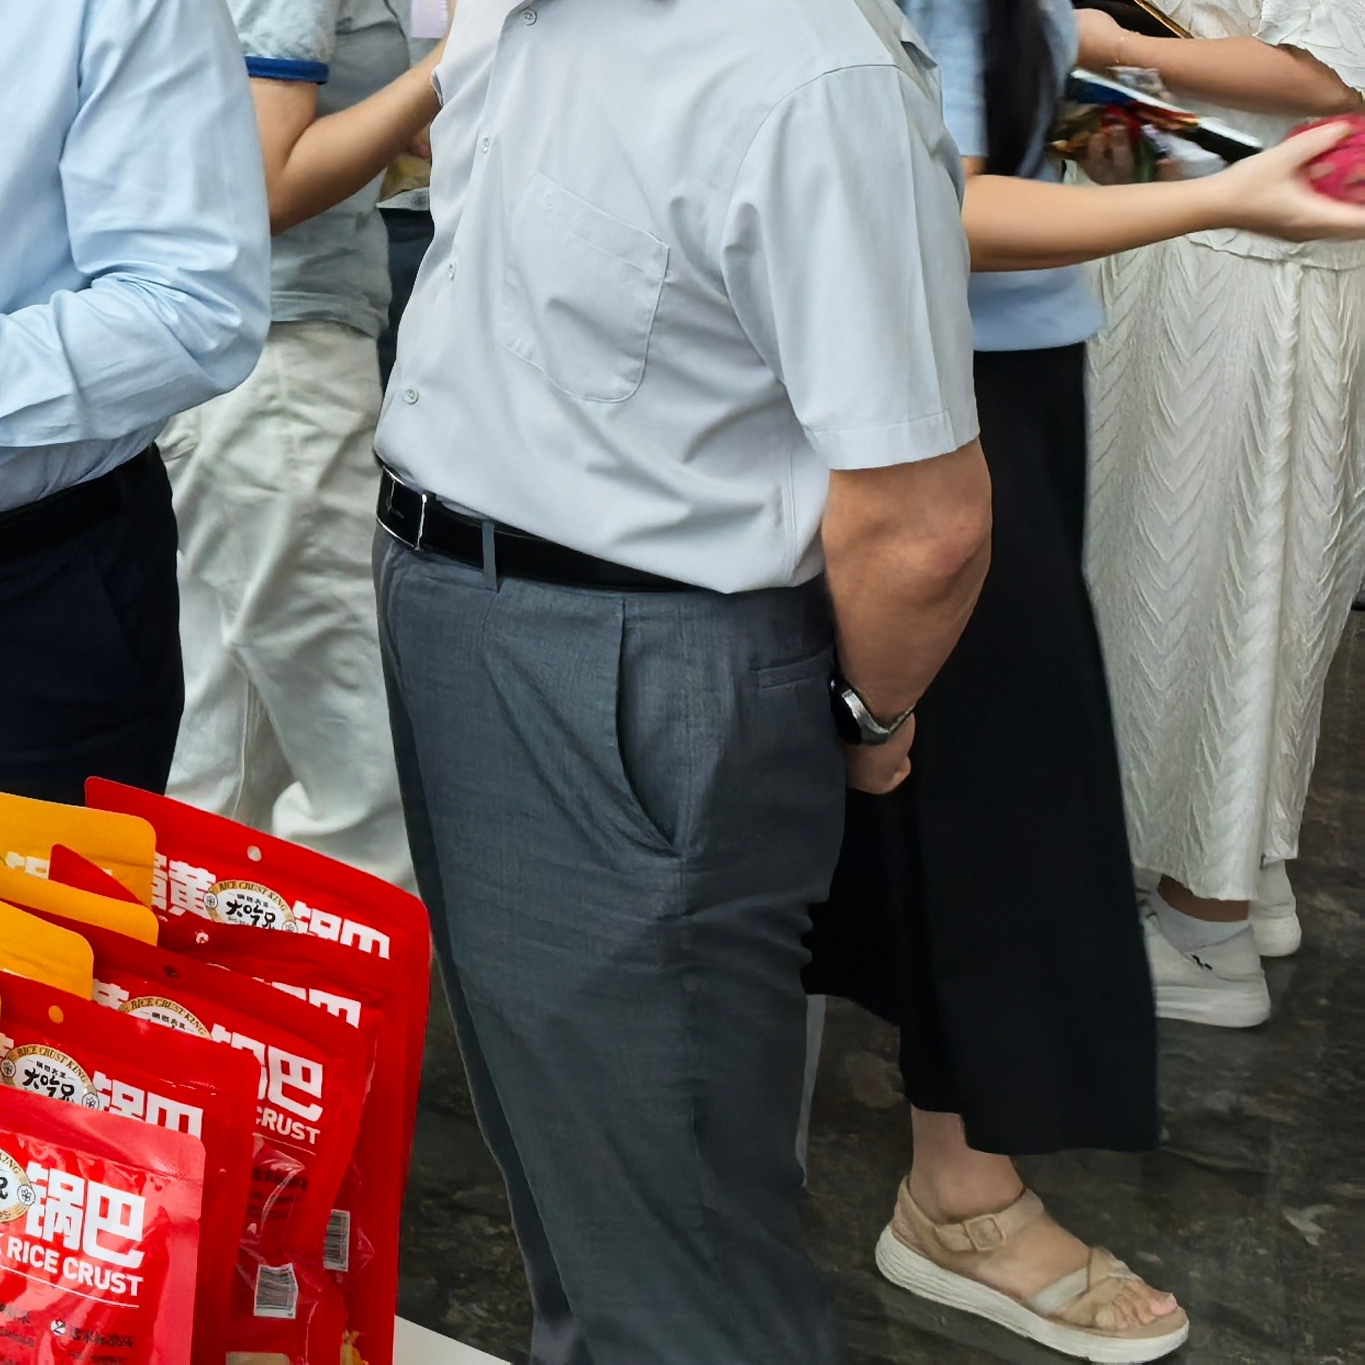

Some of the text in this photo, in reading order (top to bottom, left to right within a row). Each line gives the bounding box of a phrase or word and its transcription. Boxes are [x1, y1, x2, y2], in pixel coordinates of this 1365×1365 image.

[130, 997, 154, 1011] RICE
[155, 998, 185, 1019] CRUST
[16, 1045, 38, 1058] RICE
[39, 1046, 69, 1065] CRUST
[25, 1160, 145, 1268] 锅巴
[7, 1238, 61, 1276] RICE
[62, 1255, 144, 1297] CRUST
